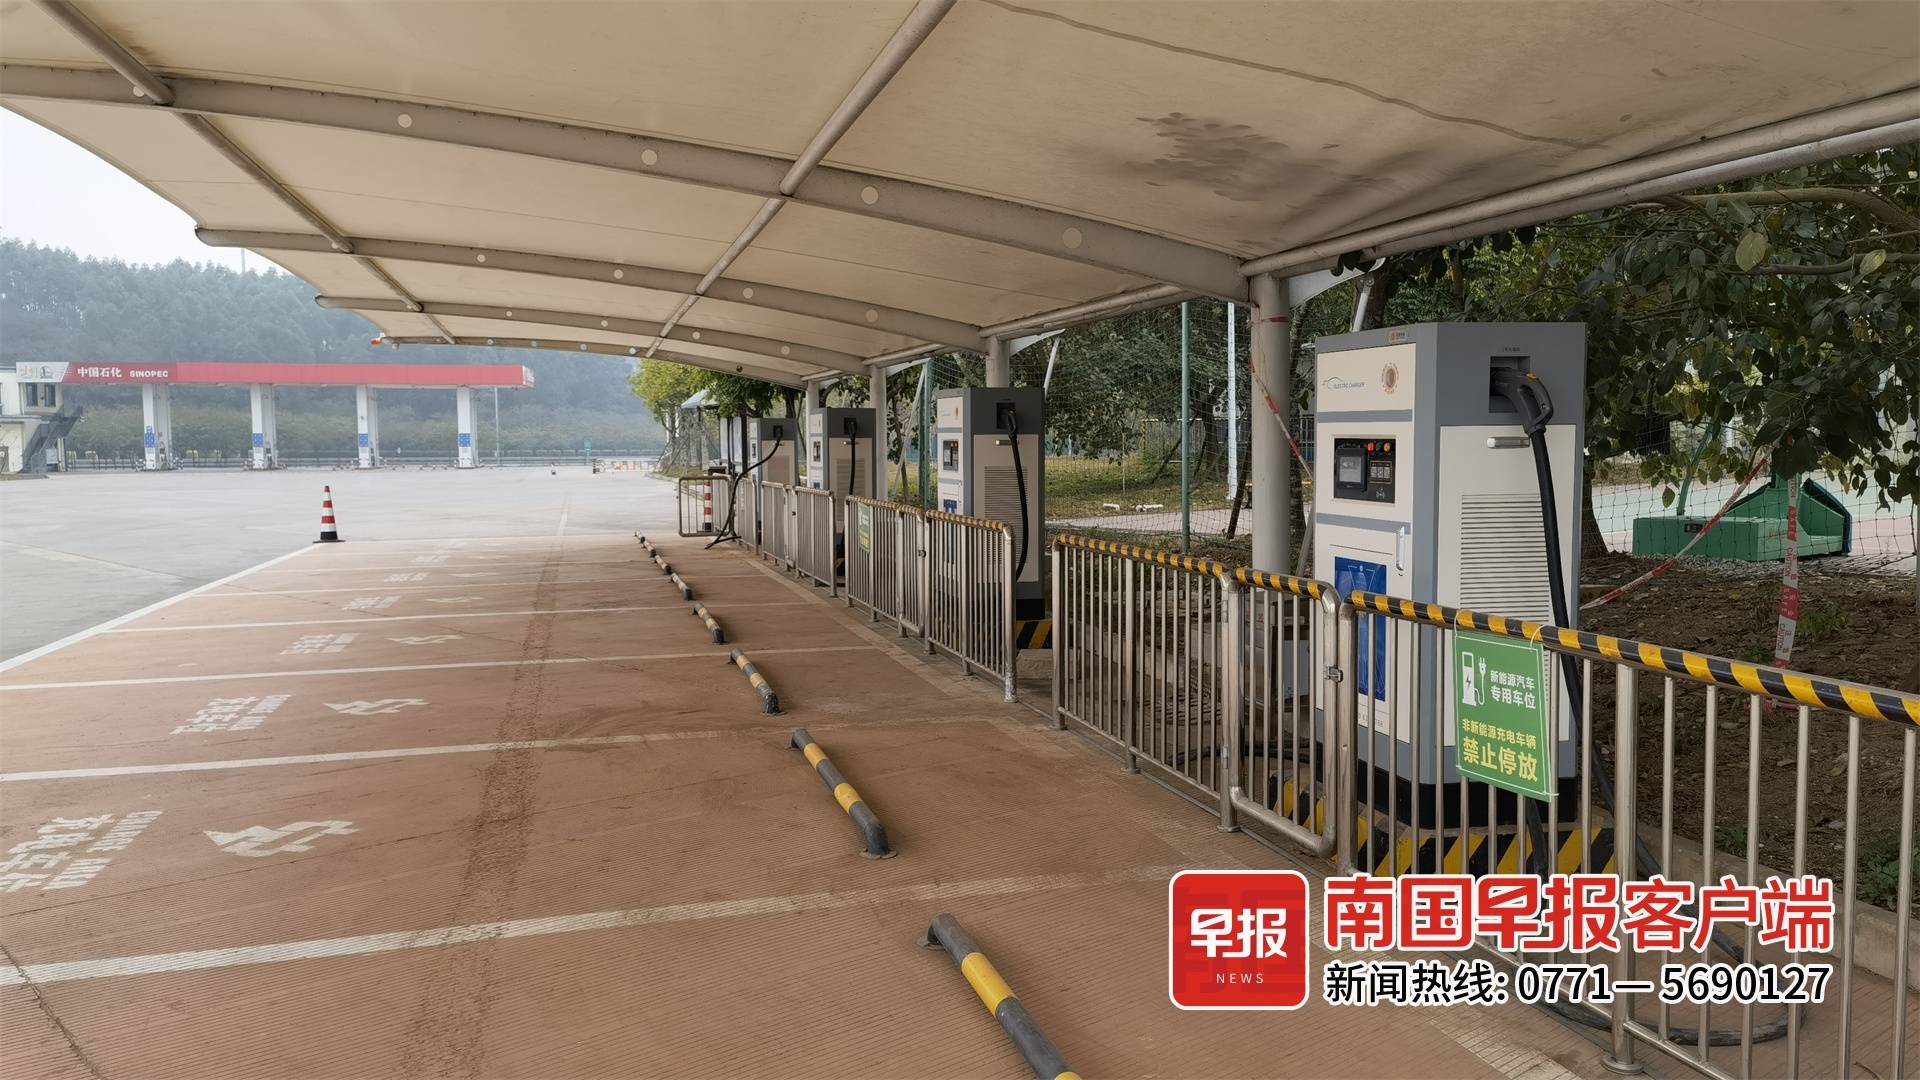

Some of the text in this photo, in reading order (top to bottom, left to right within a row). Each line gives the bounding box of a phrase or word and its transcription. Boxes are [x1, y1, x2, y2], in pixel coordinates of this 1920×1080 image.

[77, 366, 122, 378] 中国石化
[129, 369, 169, 378] SINOPEC
[1490, 670, 1535, 691] 新能源汽车
[1490, 685, 1536, 709] 专用车位
[1462, 718, 1537, 749] 非新能源充电车辆
[1463, 736, 1538, 782] 禁止停放
